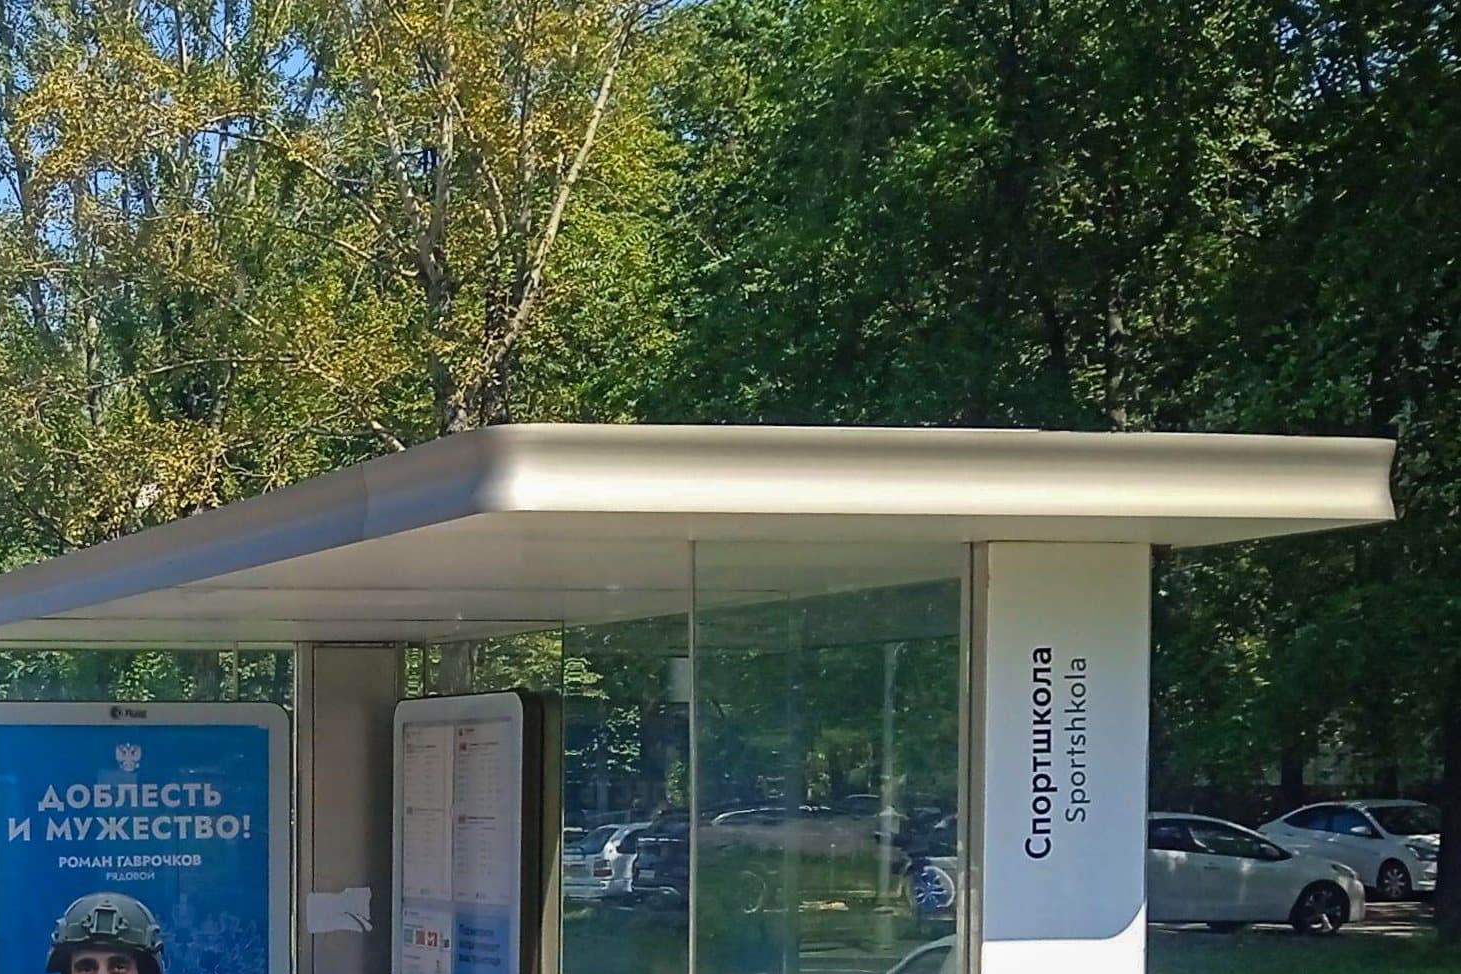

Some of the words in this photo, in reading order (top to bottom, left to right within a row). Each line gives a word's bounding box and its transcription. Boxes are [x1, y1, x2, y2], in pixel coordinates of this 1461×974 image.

[1024, 647, 1058, 860] Спортшкола
[1063, 658, 1091, 823] Sportshkola
[38, 783, 222, 812] ДОБЛЕСТЬ
[8, 817, 31, 842] И
[45, 814, 251, 841] МУЖЕСТВО!
[58, 856, 113, 869] РОМАН
[117, 854, 202, 868] ГАВРОЧКОВ
[105, 871, 156, 882] РЯДОВОЙ
